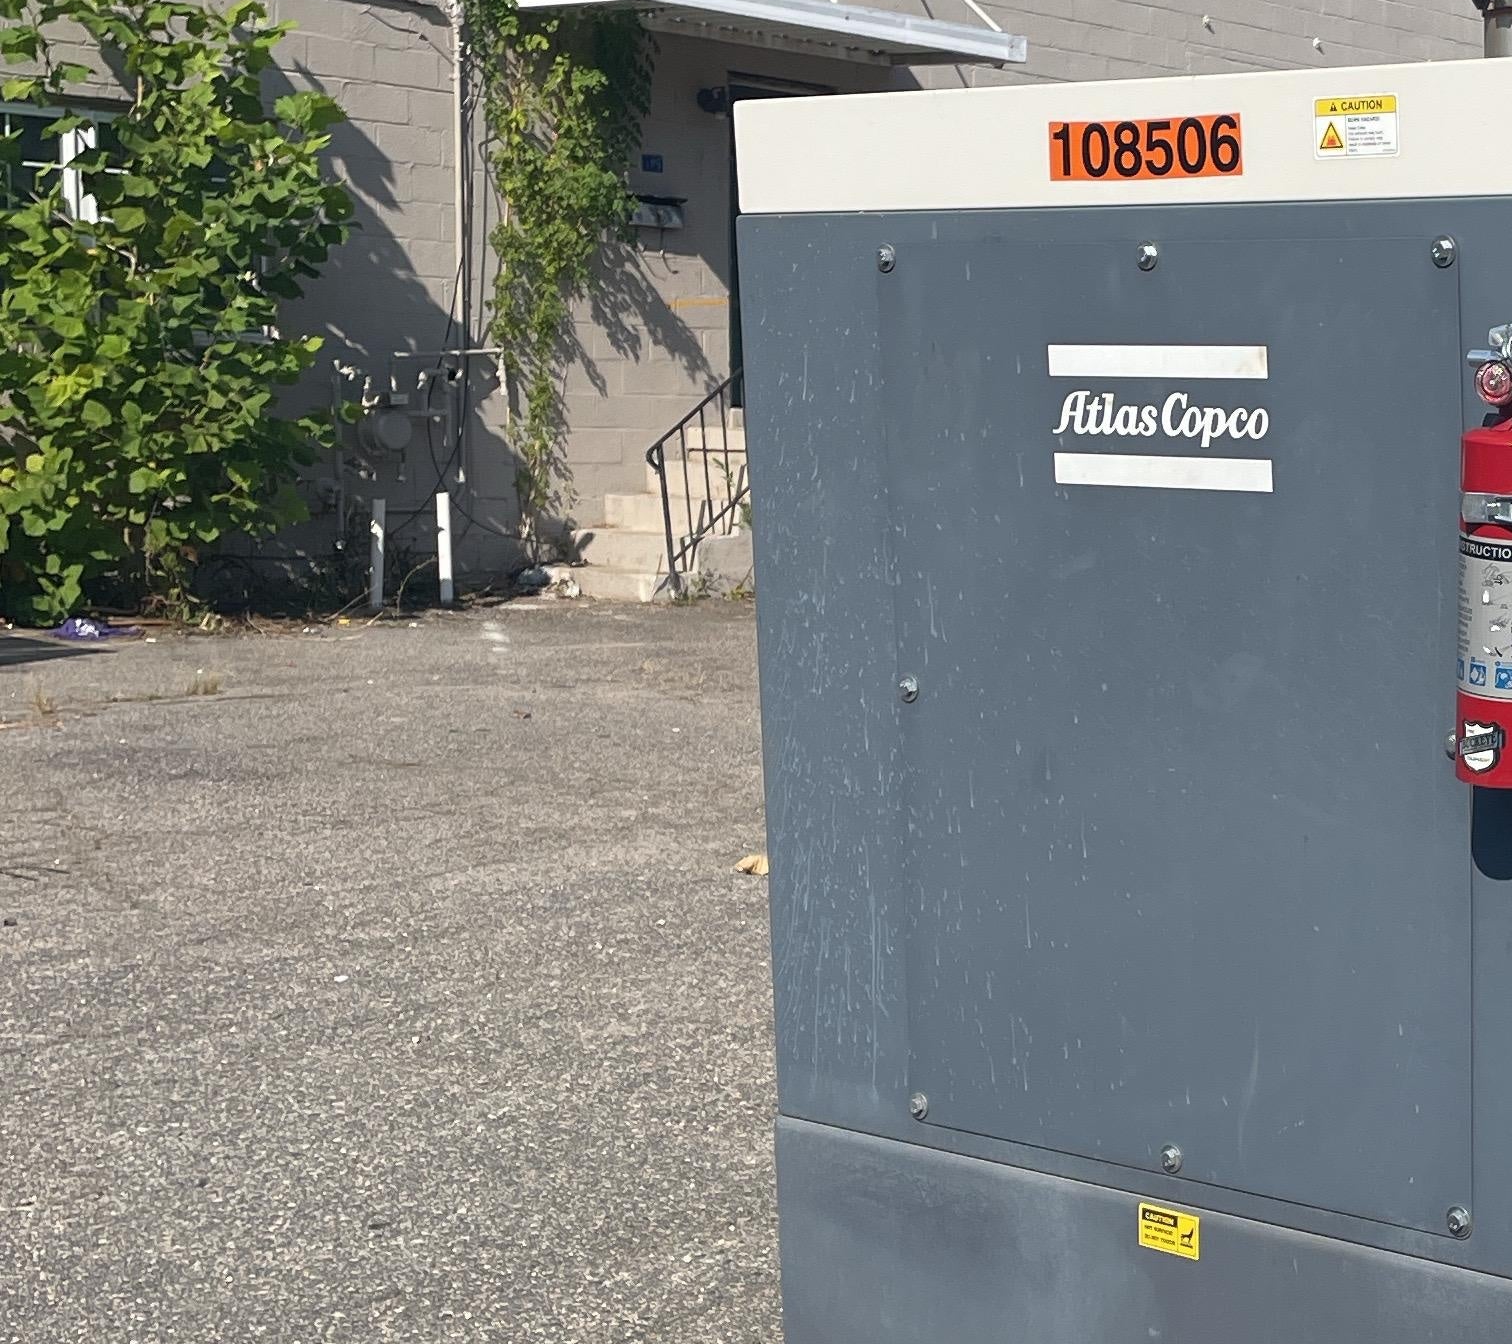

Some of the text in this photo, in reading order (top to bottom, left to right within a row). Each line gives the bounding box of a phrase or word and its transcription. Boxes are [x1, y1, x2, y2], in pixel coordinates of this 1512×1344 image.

[1341, 99, 1383, 111] CAUTION
[1052, 115, 1240, 177] 108506
[1052, 390, 1269, 448] Atlas Copco
[1145, 1211, 1175, 1226] CAUTION
